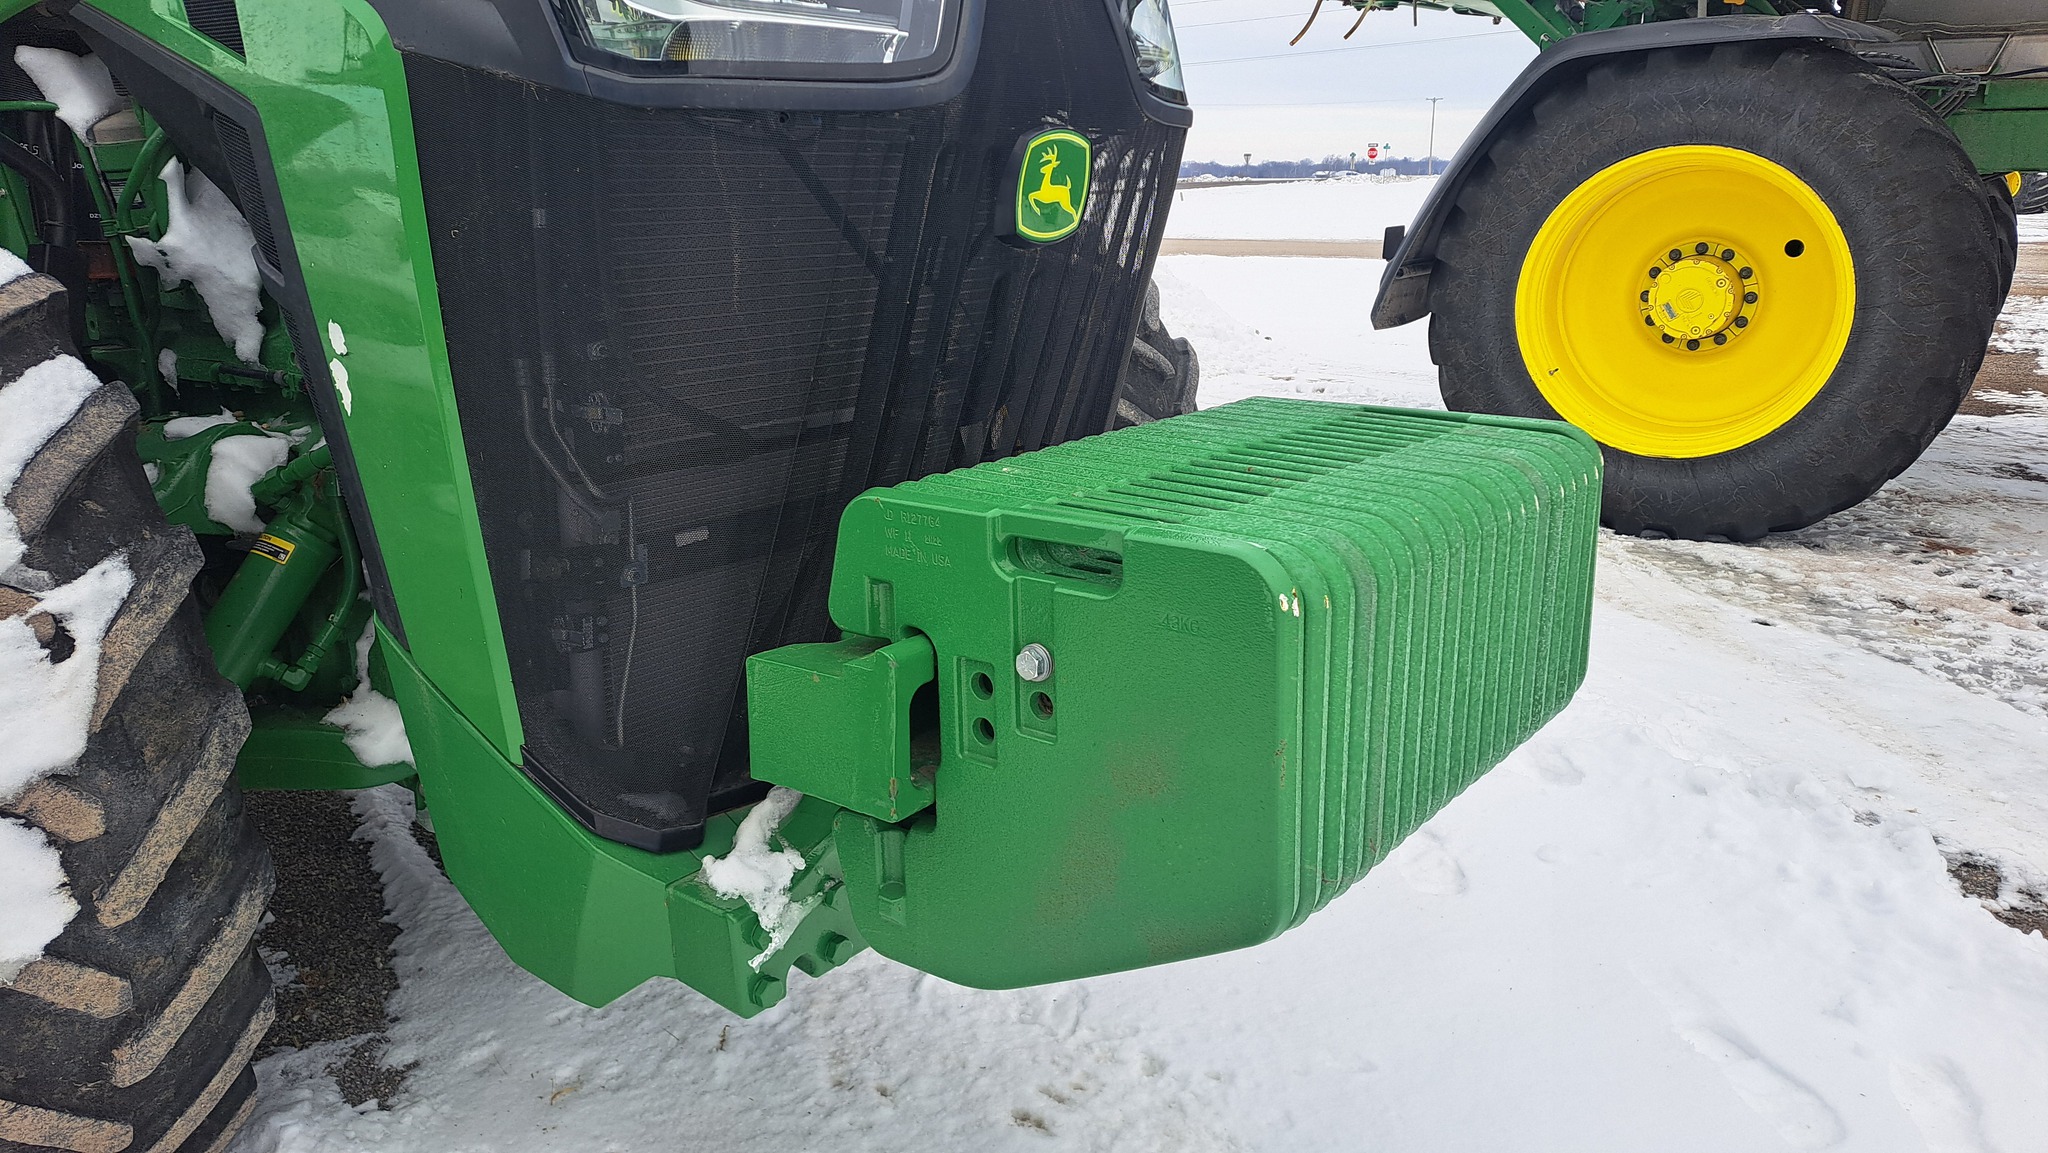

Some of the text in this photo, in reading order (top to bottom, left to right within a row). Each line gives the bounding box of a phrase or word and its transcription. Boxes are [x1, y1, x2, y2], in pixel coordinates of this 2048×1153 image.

[884, 527, 900, 539] WF
[885, 545, 952, 568] MADE IN USA
